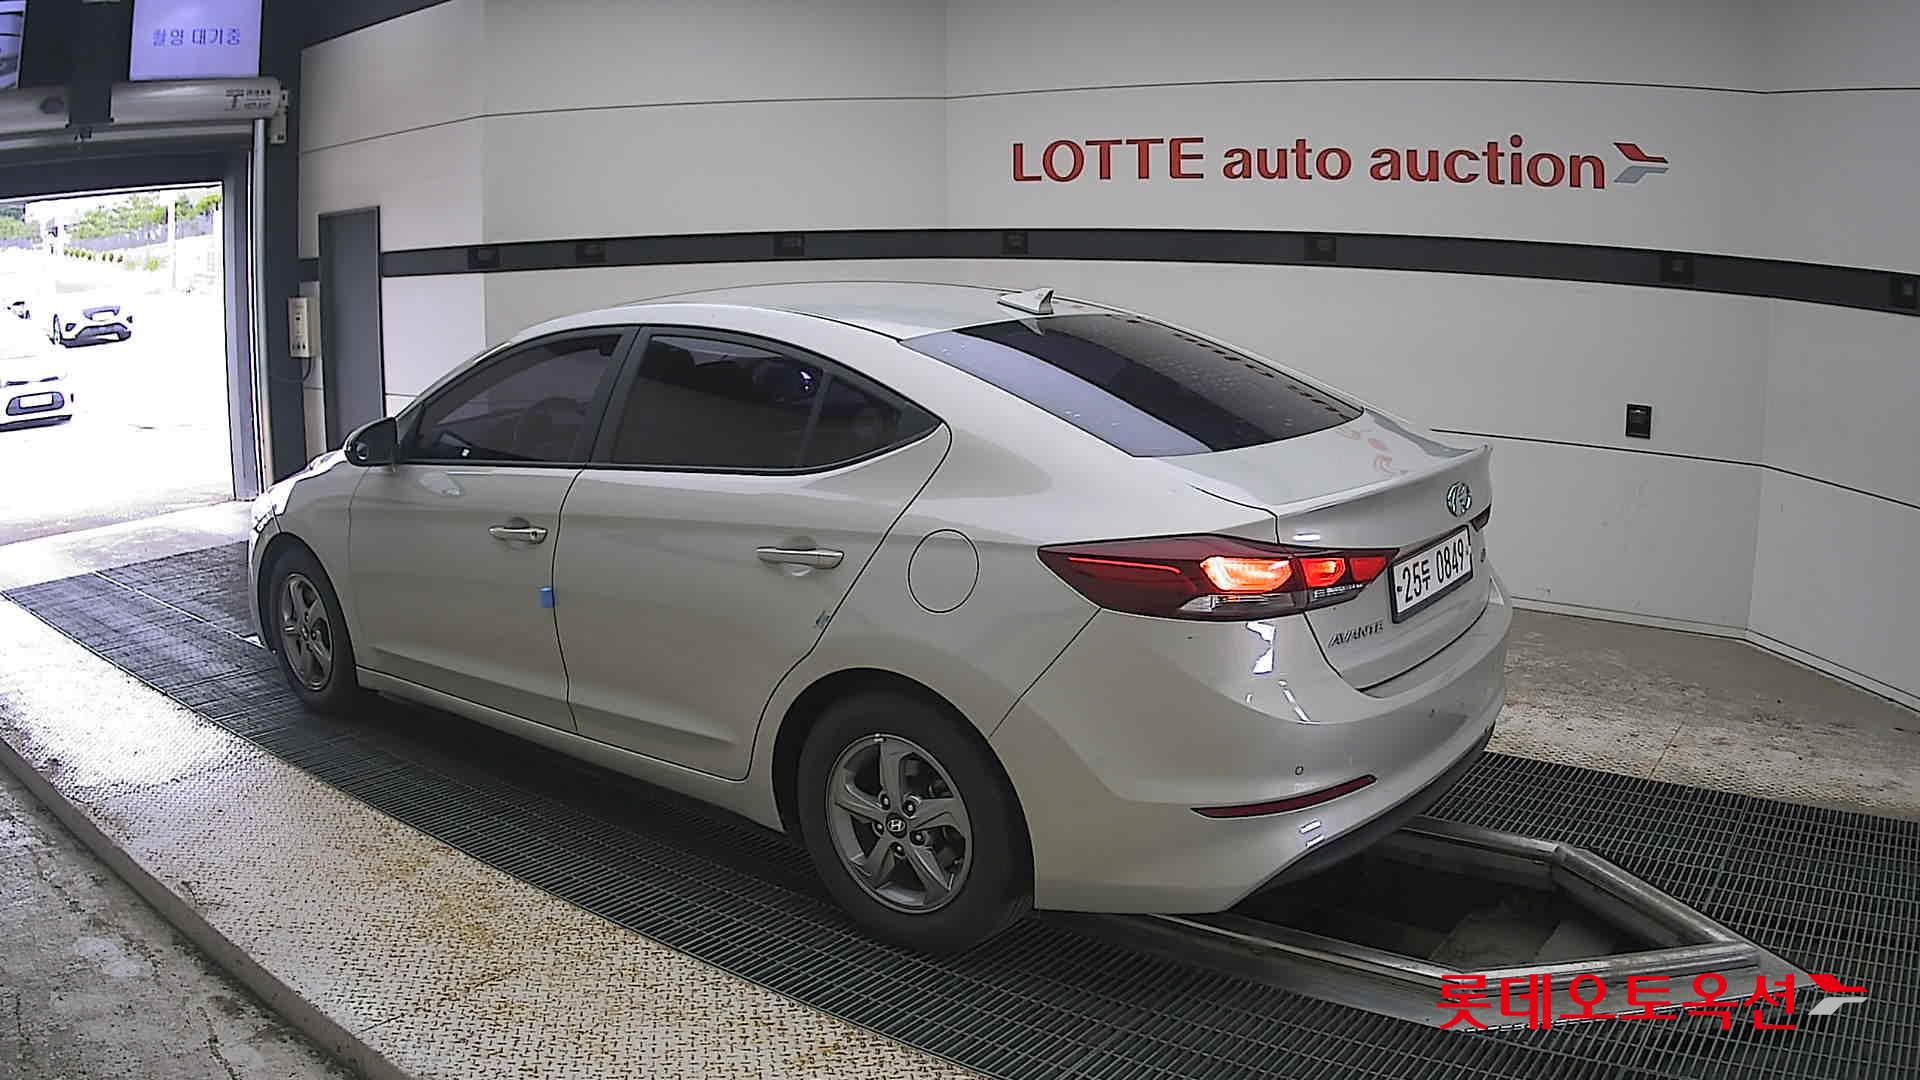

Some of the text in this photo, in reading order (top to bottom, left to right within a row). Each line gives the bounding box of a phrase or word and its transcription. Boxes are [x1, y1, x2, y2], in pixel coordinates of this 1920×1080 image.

[192, 28, 241, 45] 대기중
[1012, 135, 1605, 190] LOTTE auto auction
[1402, 538, 1464, 603] 25두 0849
[1329, 620, 1384, 648] AVANTE
